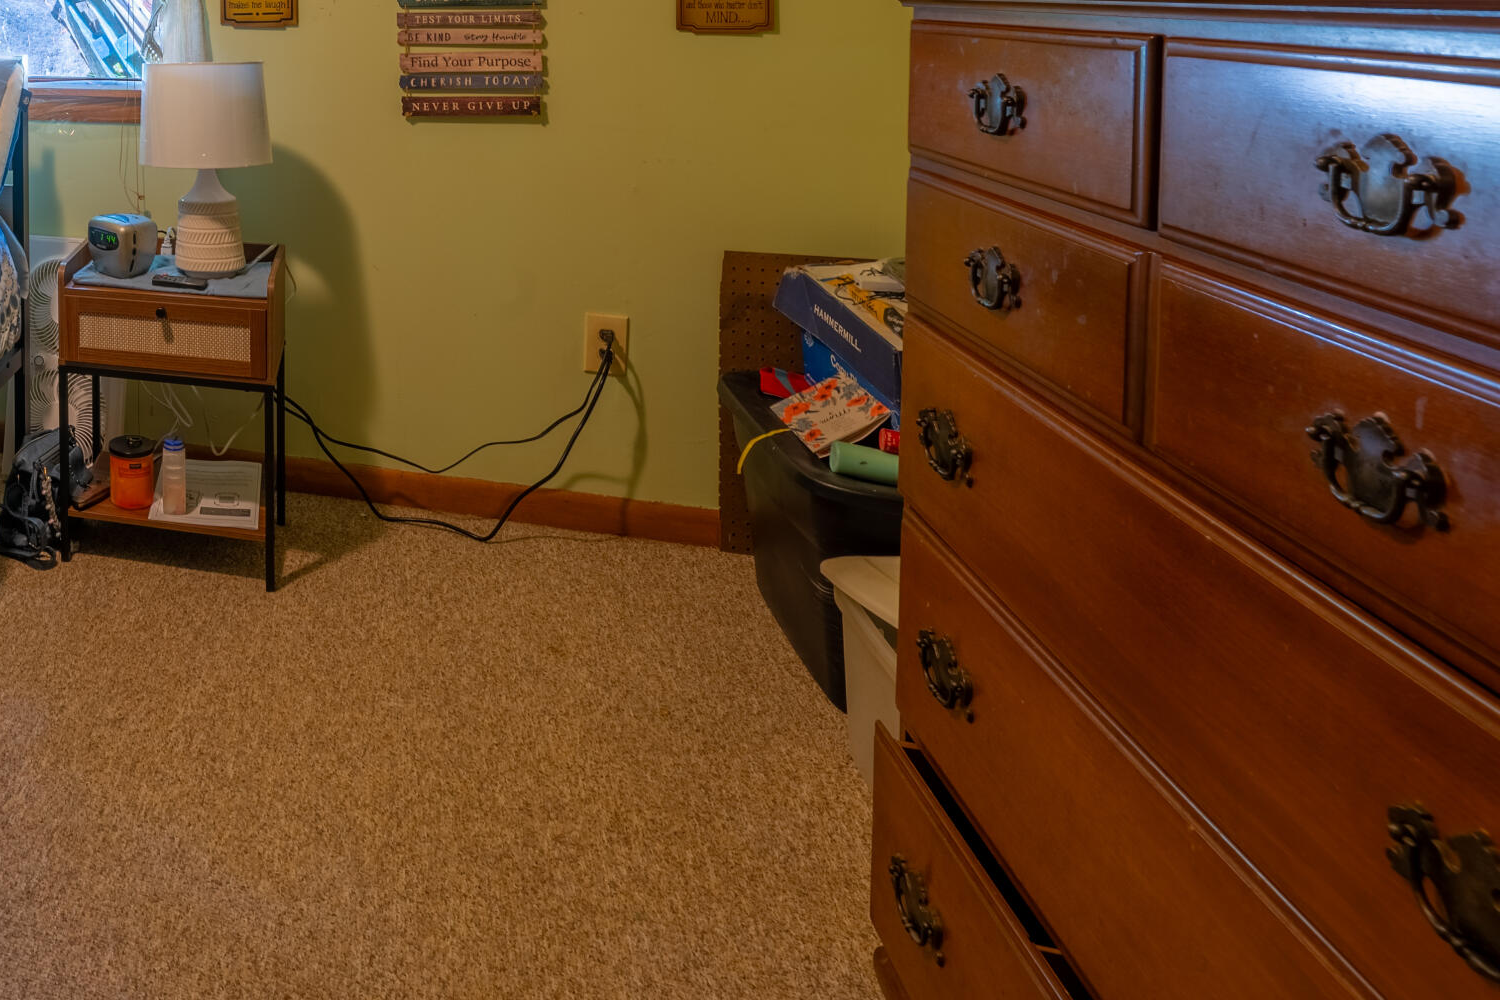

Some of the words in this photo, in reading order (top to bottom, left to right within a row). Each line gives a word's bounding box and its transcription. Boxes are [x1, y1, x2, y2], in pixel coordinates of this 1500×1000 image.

[415, 15, 442, 25] TEST
[448, 14, 475, 24] YOUR
[481, 14, 521, 23] LIMITS
[407, 32, 419, 42] BE
[426, 32, 451, 42] KIND
[410, 56, 439, 68] Find
[443, 56, 474, 68] Your
[478, 56, 532, 69] Purpose
[410, 76, 472, 88] CHERISH
[484, 75, 531, 86] TODAY
[412, 101, 460, 112] NEVER
[467, 101, 504, 111] GIVE
[512, 101, 531, 110] UP
[813, 303, 862, 353] HAMMERMILL
